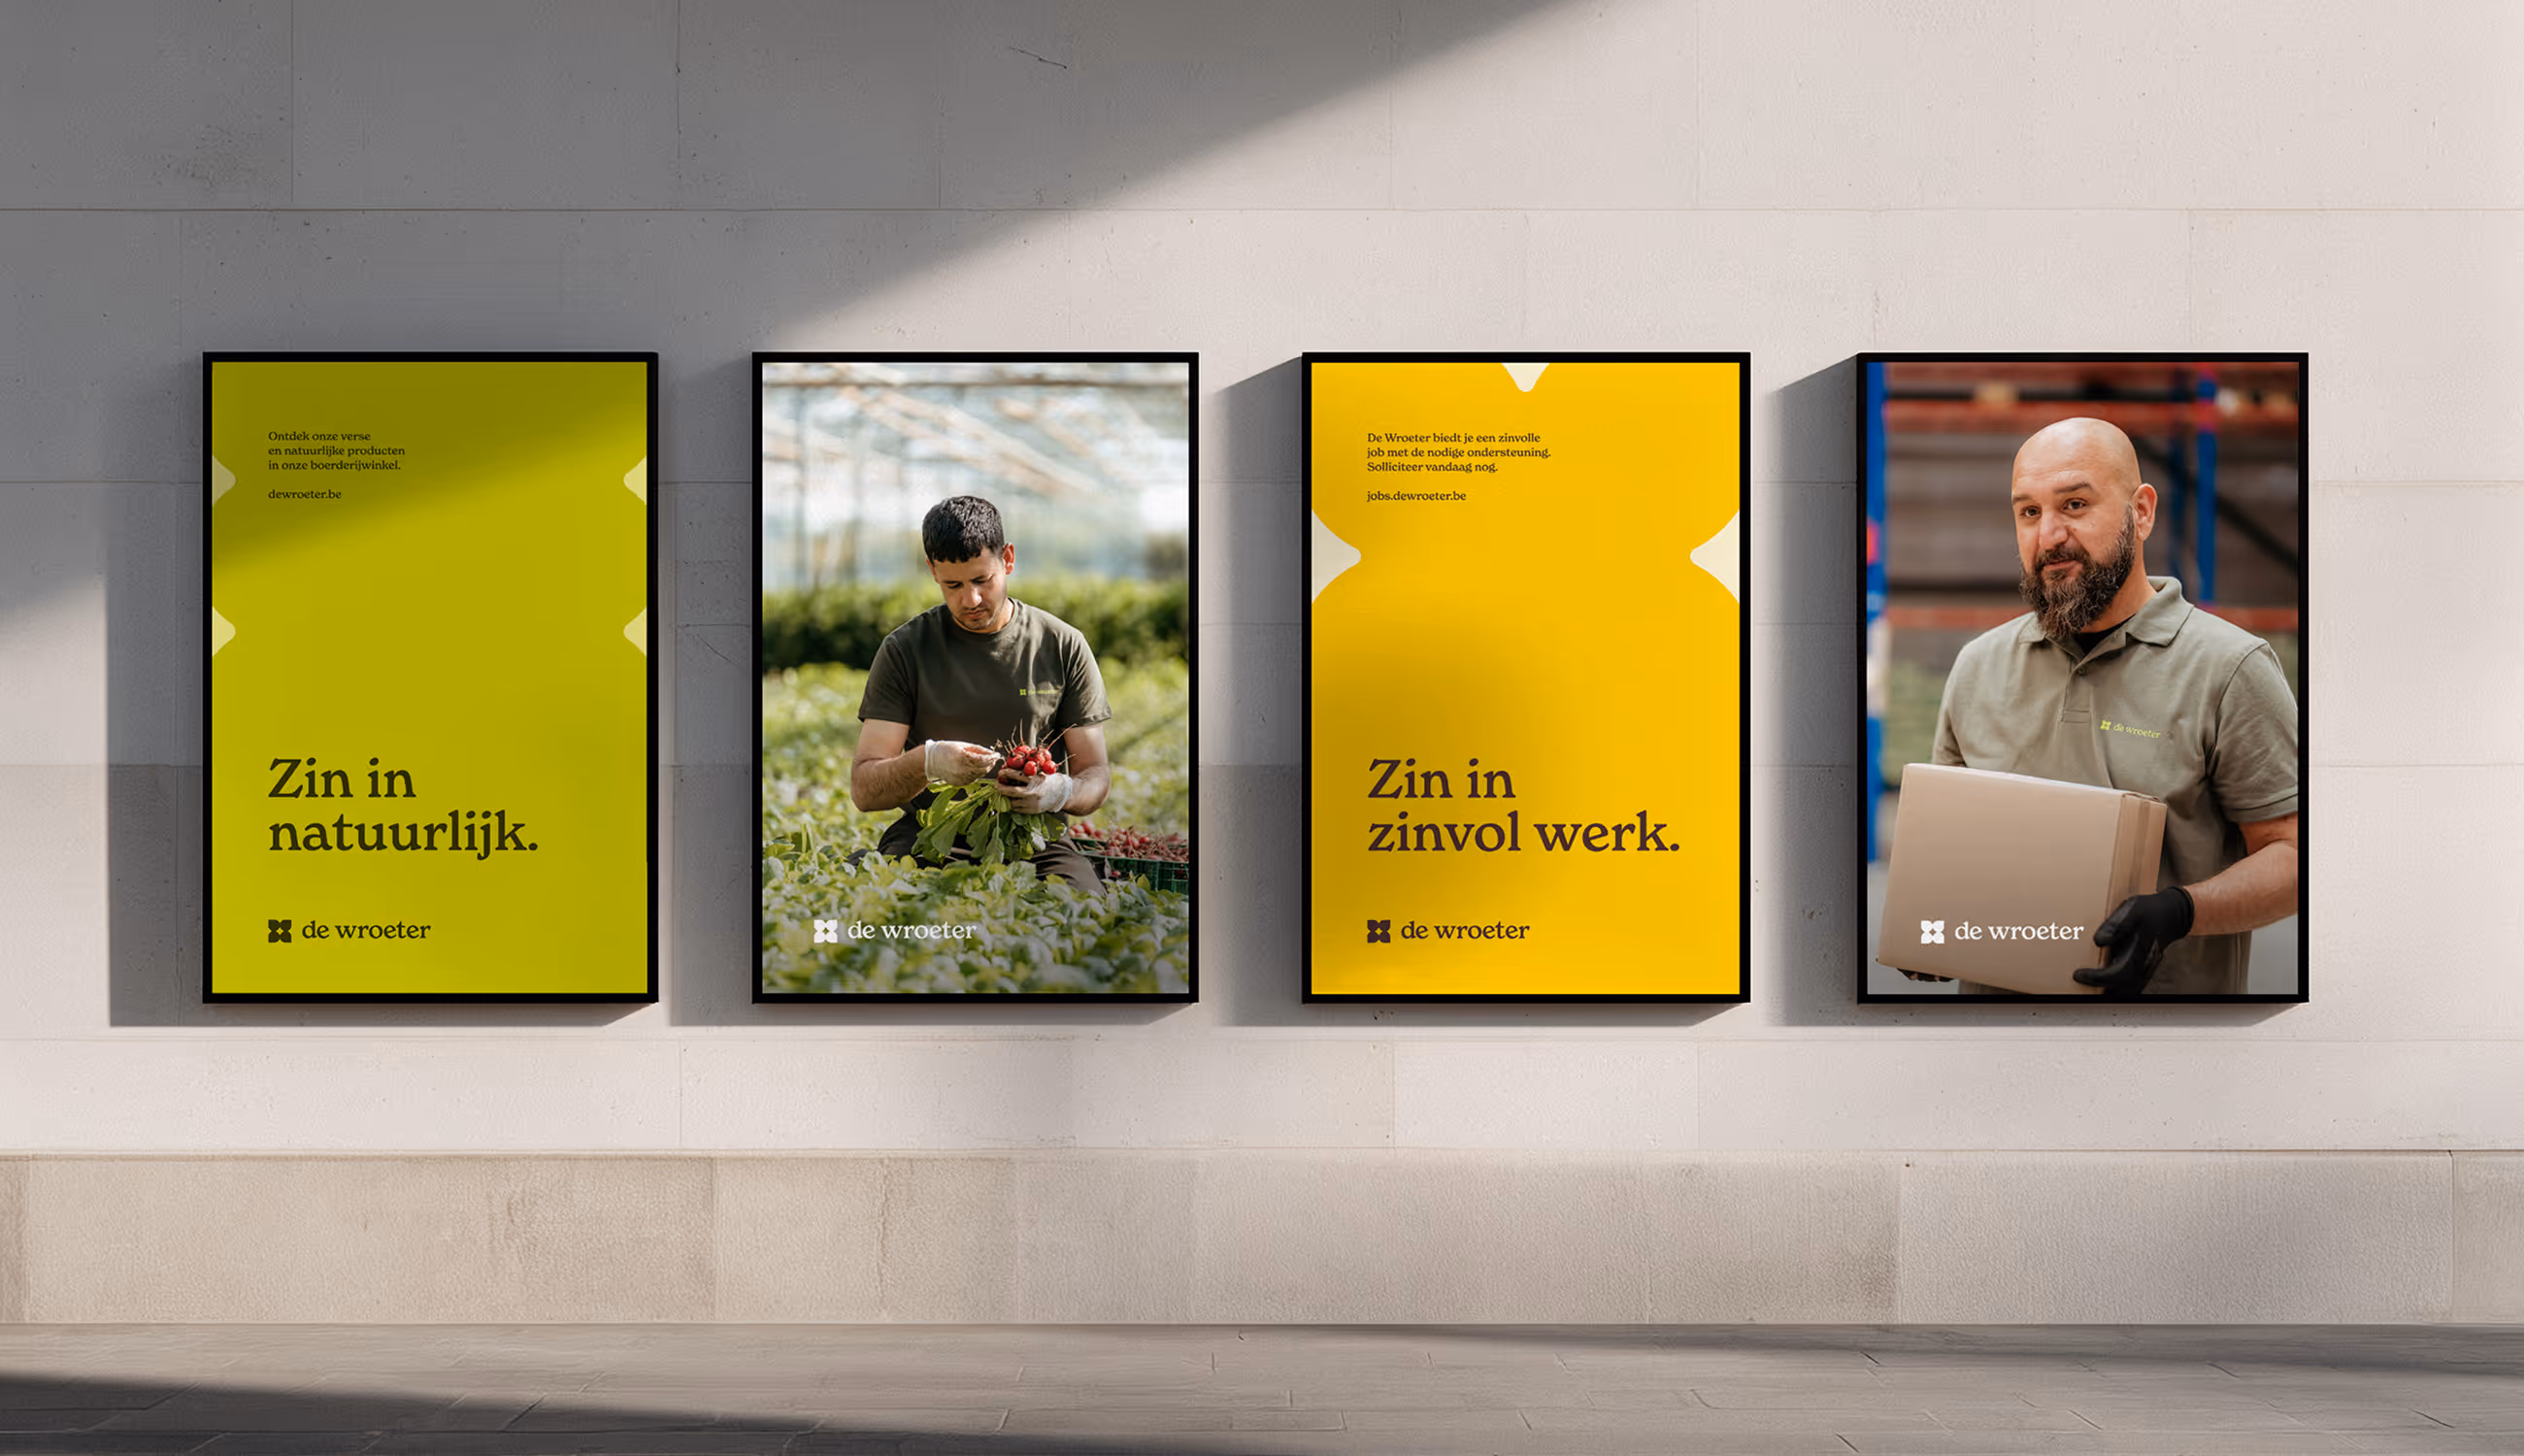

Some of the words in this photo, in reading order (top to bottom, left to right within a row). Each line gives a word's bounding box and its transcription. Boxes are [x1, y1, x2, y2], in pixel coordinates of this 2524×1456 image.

[268, 430, 311, 443] Ontdek
[312, 433, 339, 443] onze
[340, 433, 372, 443] verse
[1367, 432, 1383, 444] De
[1384, 432, 1432, 444] Wroeter
[1432, 432, 1463, 444] biedt
[1463, 432, 1475, 446] je
[1498, 432, 1542, 444] zinvolle
[268, 447, 282, 456] en
[283, 445, 346, 459] natuurlijke
[347, 445, 406, 459] producten
[1366, 446, 1385, 460] job
[1386, 447, 1409, 458] met
[1411, 446, 1425, 458] de
[1427, 446, 1465, 460] nodige
[1467, 446, 1552, 460] ondersteuning.
[268, 459, 280, 471] in
[281, 461, 309, 471] onze
[310, 458, 402, 473] boerderijwinkel.
[1367, 460, 1424, 473] Solliciteer
[1425, 460, 1473, 475] vandaag
[1474, 463, 1499, 475] nog.
[268, 488, 342, 500] dewroeter.be
[1366, 490, 1467, 503] jobs.dewroeter.be
[2113, 723, 2125, 732] de
[268, 757, 354, 799] Zin
[367, 756, 417, 798] in
[1367, 757, 1454, 800] Zin
[1466, 757, 1517, 799] in
[268, 809, 540, 861] natuurlijk.
[1367, 810, 1522, 853] zinvol
[1533, 810, 1680, 852] werk.
[301, 919, 330, 940] de
[334, 920, 432, 940] wroeter
[847, 919, 876, 940] de
[880, 921, 978, 940] wroeter
[1400, 920, 1429, 940] de
[1433, 920, 1531, 940] wroeter
[1954, 920, 1982, 941] de
[1987, 921, 2085, 941] wroeter
